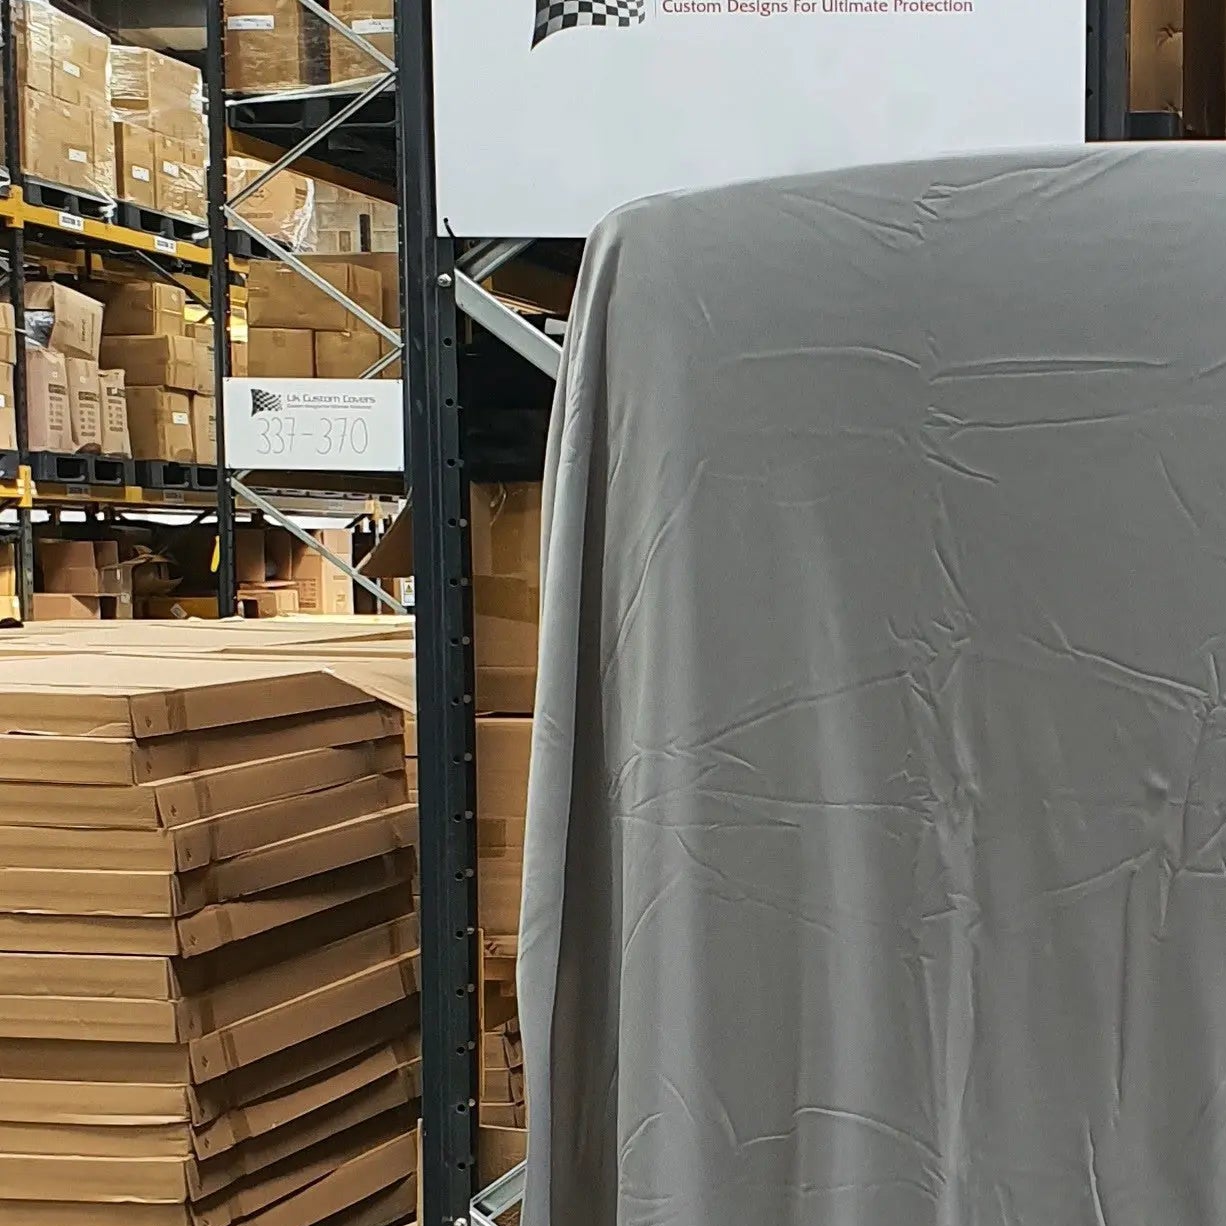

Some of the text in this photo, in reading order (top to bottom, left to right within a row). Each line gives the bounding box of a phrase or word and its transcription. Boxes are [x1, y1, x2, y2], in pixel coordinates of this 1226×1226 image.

[662, 0, 974, 17] Custom Designs For Ultimate Protection
[303, 393, 341, 404] Custom
[343, 394, 376, 405] Covers
